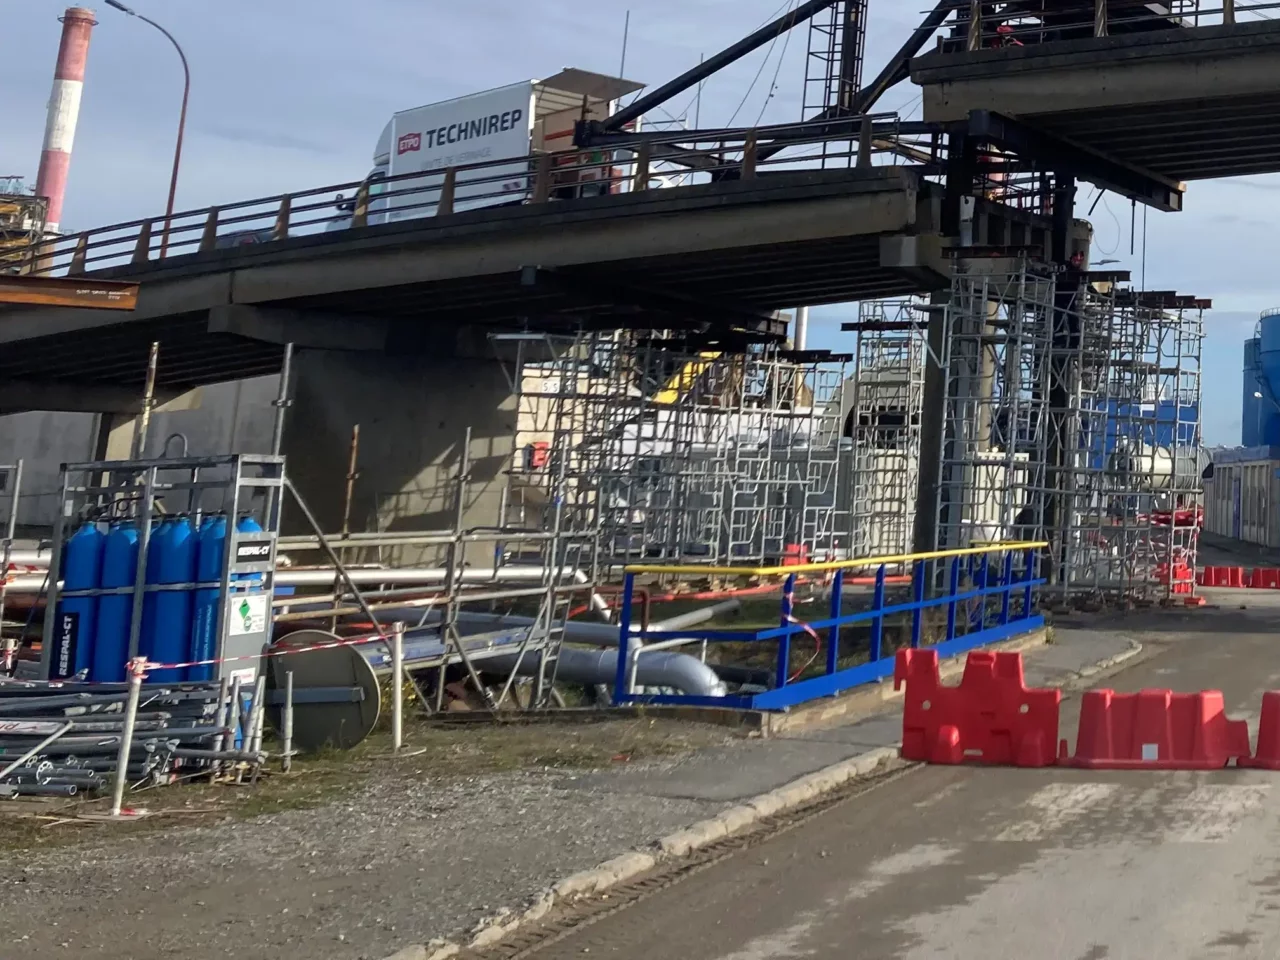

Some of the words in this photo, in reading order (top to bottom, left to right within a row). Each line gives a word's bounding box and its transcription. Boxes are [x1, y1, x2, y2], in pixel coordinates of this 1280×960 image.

[400, 138, 420, 150] ETPO
[426, 109, 522, 148] TECHNIREP
[59, 616, 73, 676] RESPAL-CT
